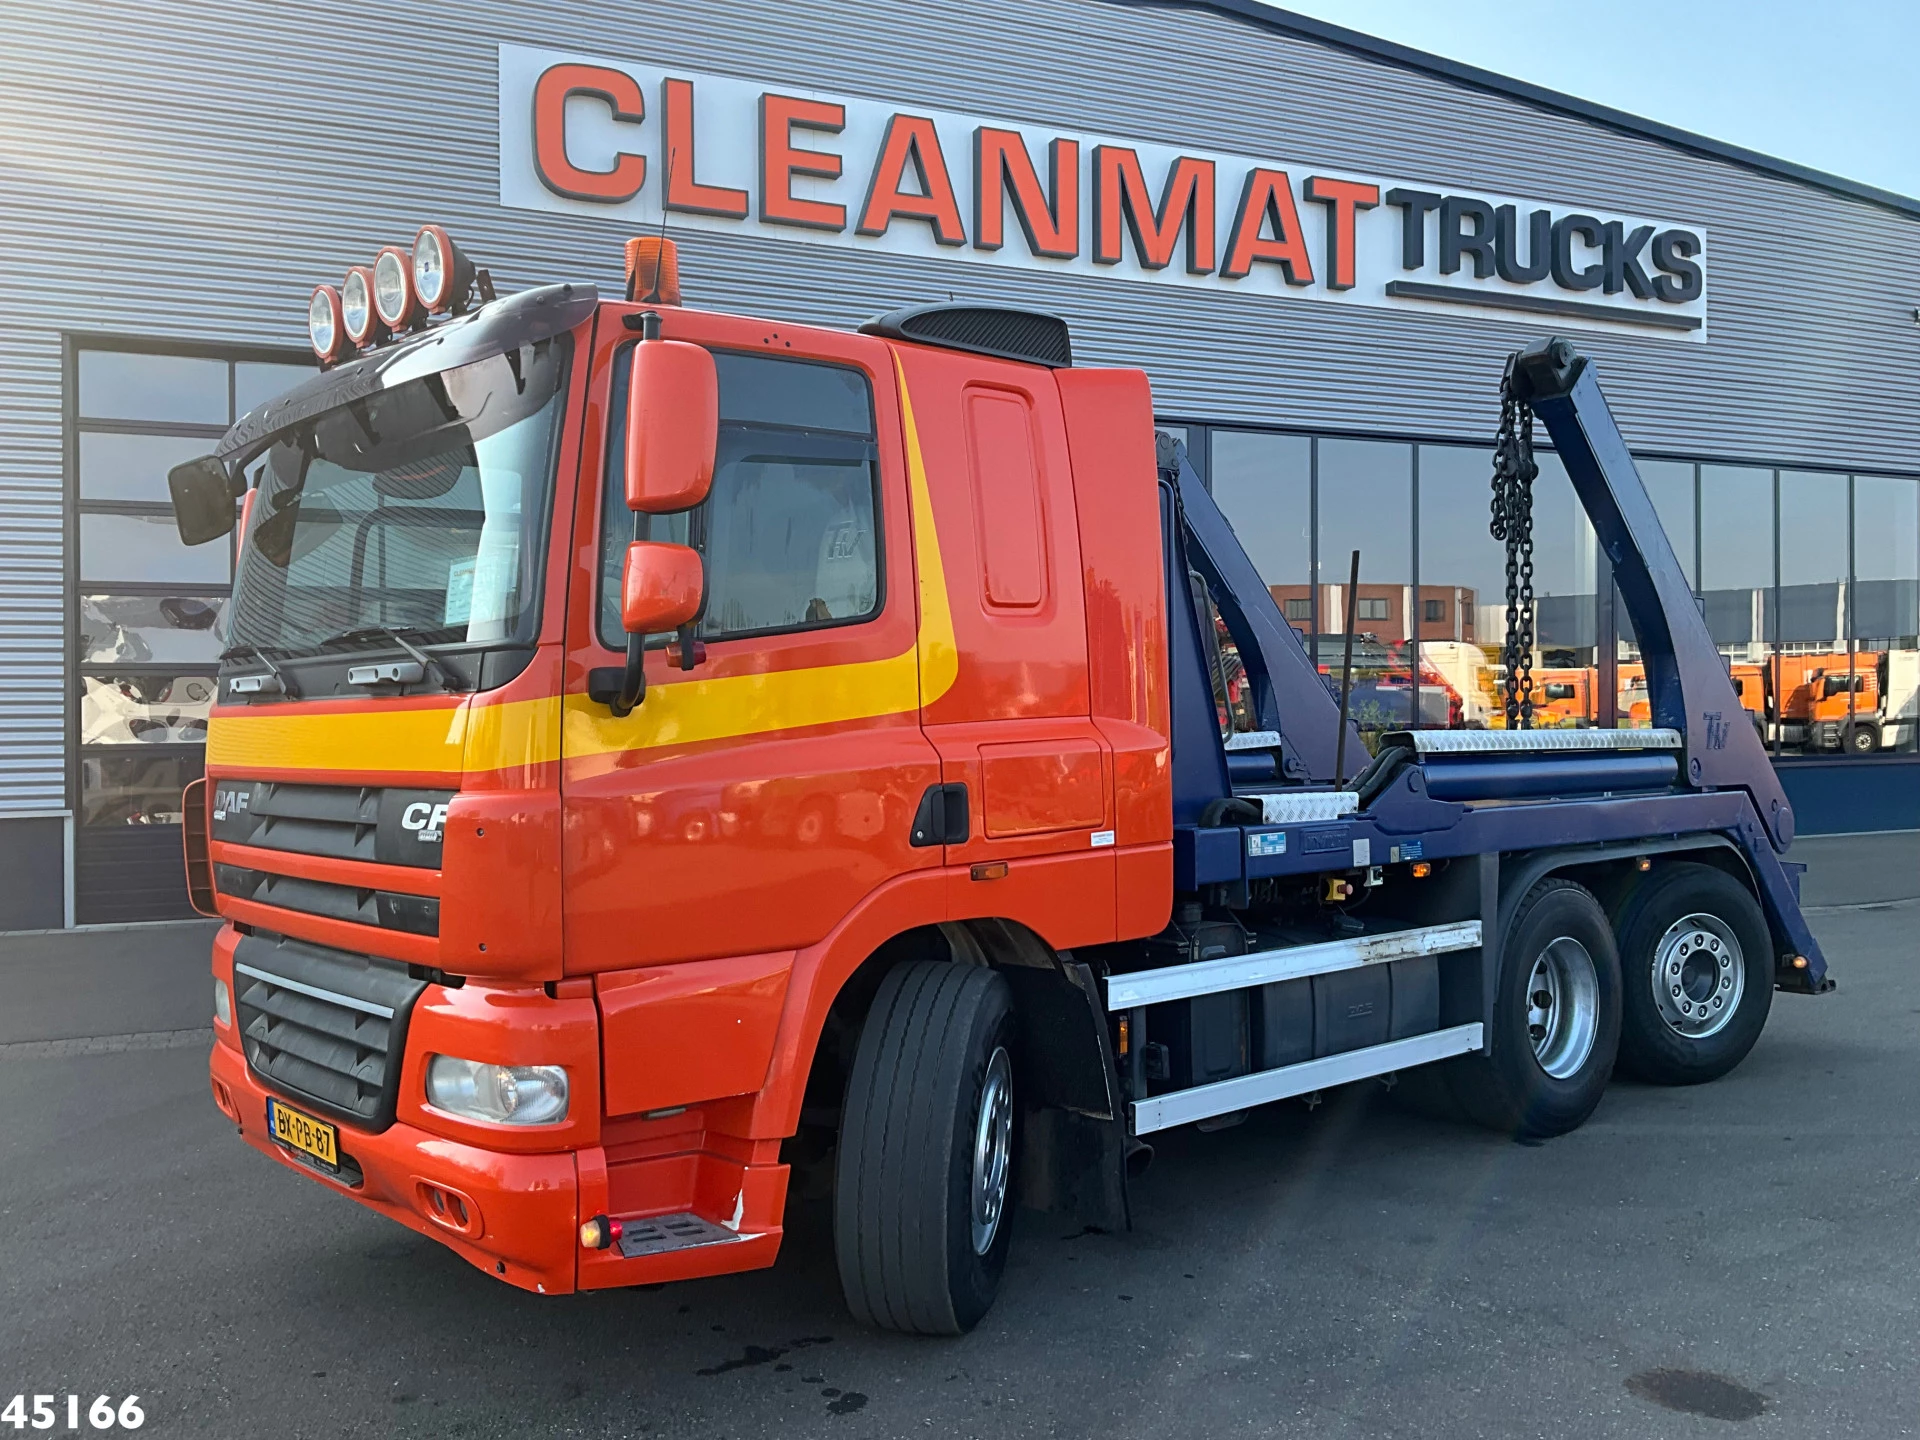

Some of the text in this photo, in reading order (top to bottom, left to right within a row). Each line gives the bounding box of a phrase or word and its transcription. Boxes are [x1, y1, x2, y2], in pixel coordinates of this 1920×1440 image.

[531, 62, 1702, 303] CLEANMAT TRUCKS
[215, 789, 250, 814] DAF
[401, 802, 449, 831] CF
[277, 1108, 330, 1157] BX-PB-87
